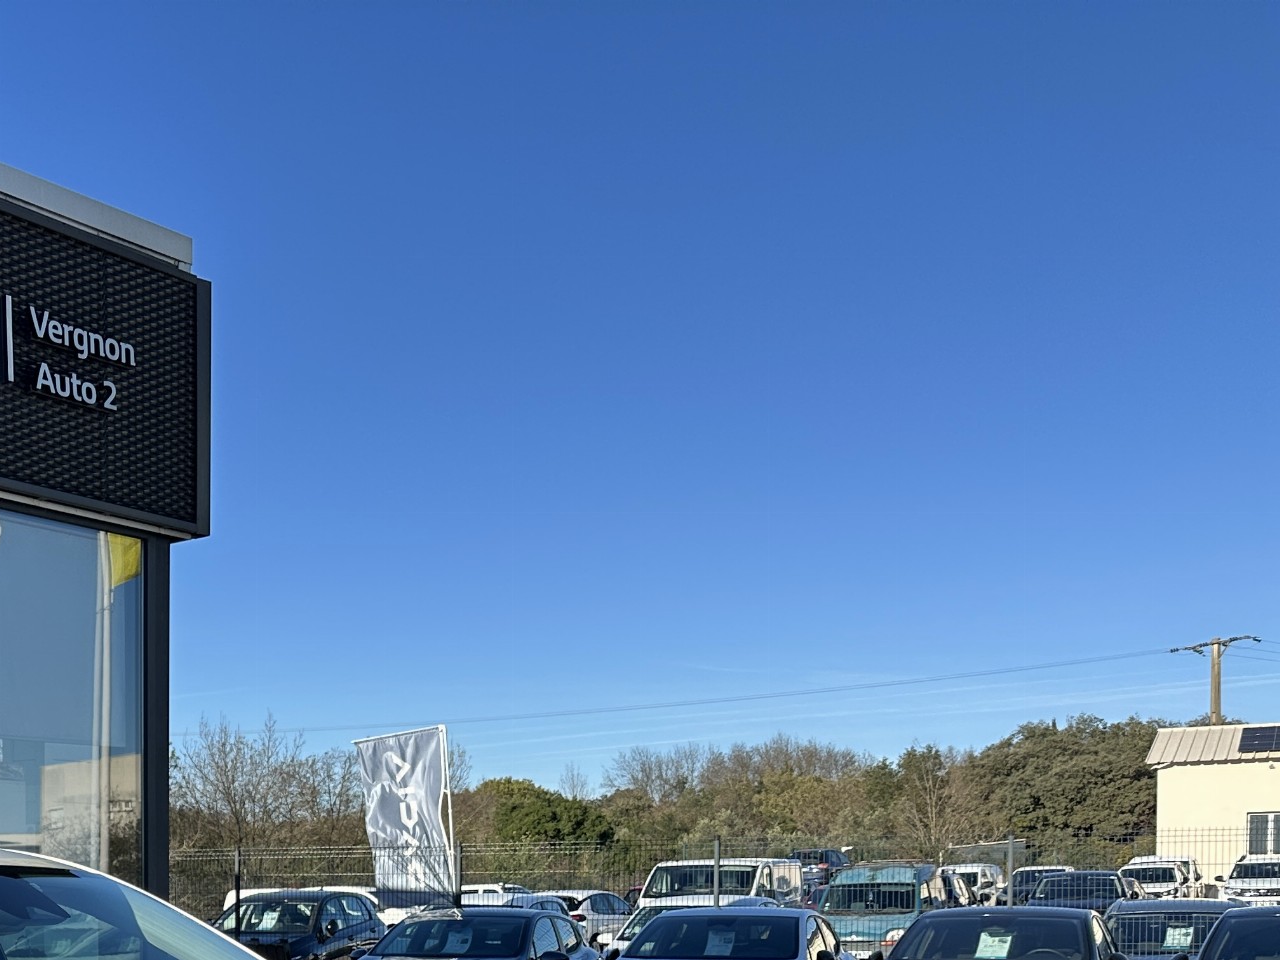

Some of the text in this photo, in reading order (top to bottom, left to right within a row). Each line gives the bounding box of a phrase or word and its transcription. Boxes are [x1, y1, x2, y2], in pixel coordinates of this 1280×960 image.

[29, 306, 136, 366] Vergnon
[36, 362, 118, 411] Auto 2
